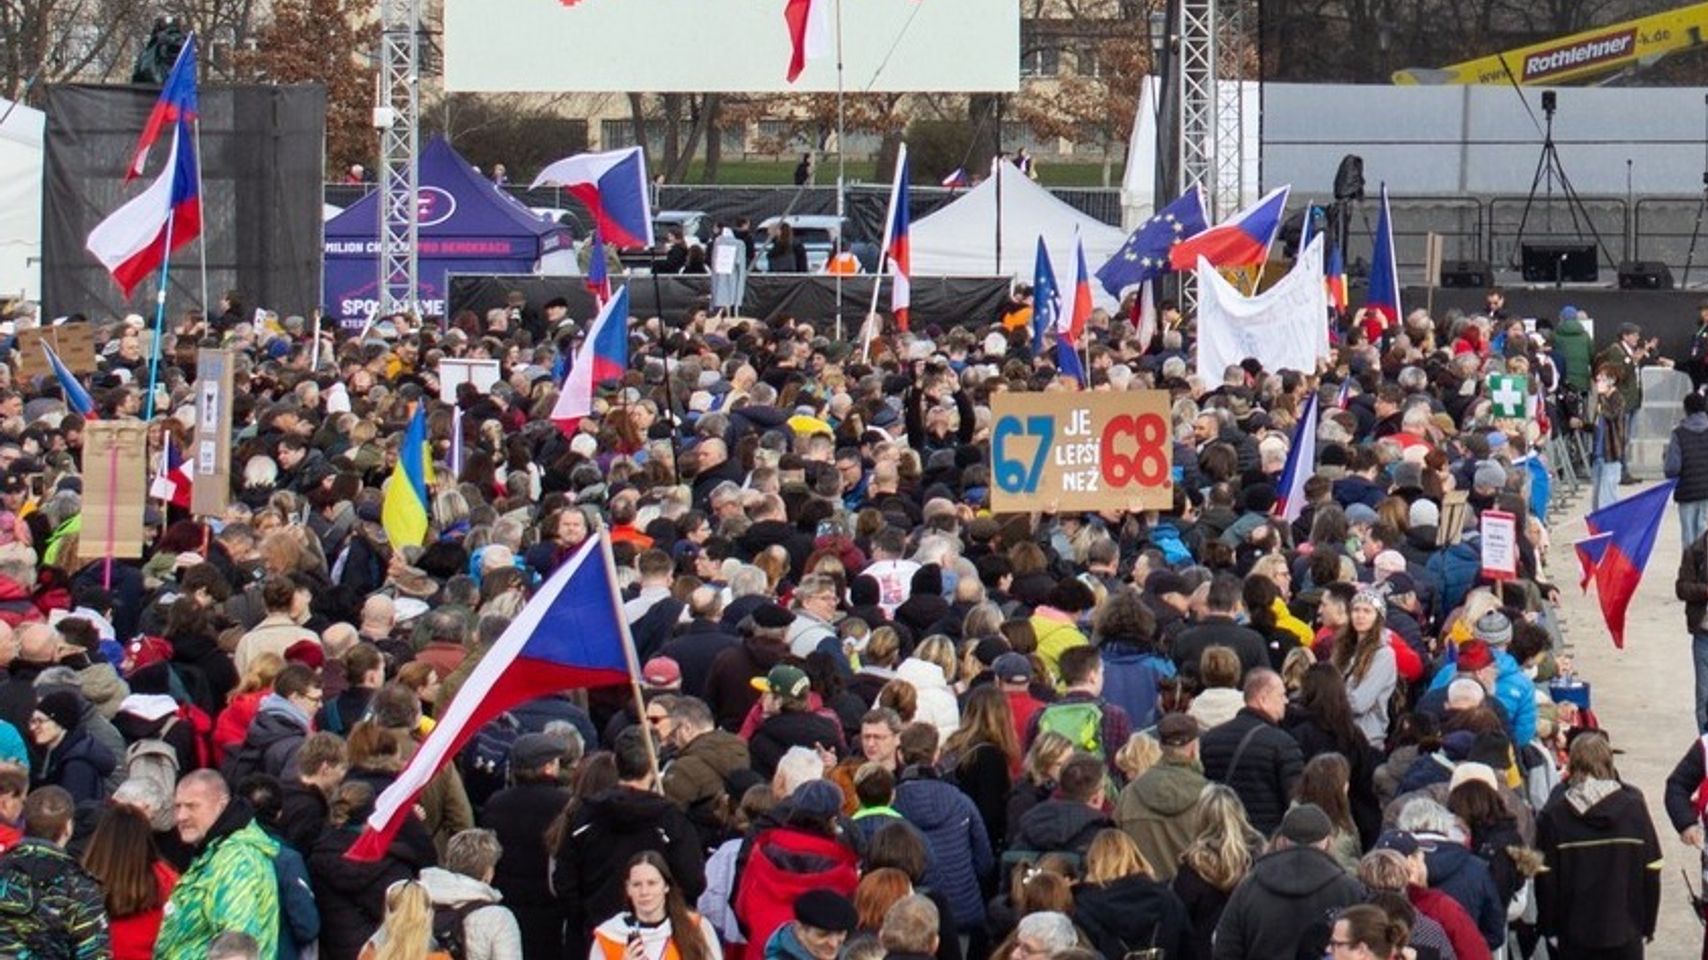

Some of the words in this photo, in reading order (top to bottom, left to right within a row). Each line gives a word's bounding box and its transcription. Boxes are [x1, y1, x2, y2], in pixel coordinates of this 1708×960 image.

[325, 242, 365, 254] MILION
[1064, 408, 1091, 437] JE
[992, 414, 1055, 495] 67
[1055, 436, 1100, 466] LEPŠÍ
[1062, 466, 1099, 492] NEŽ
